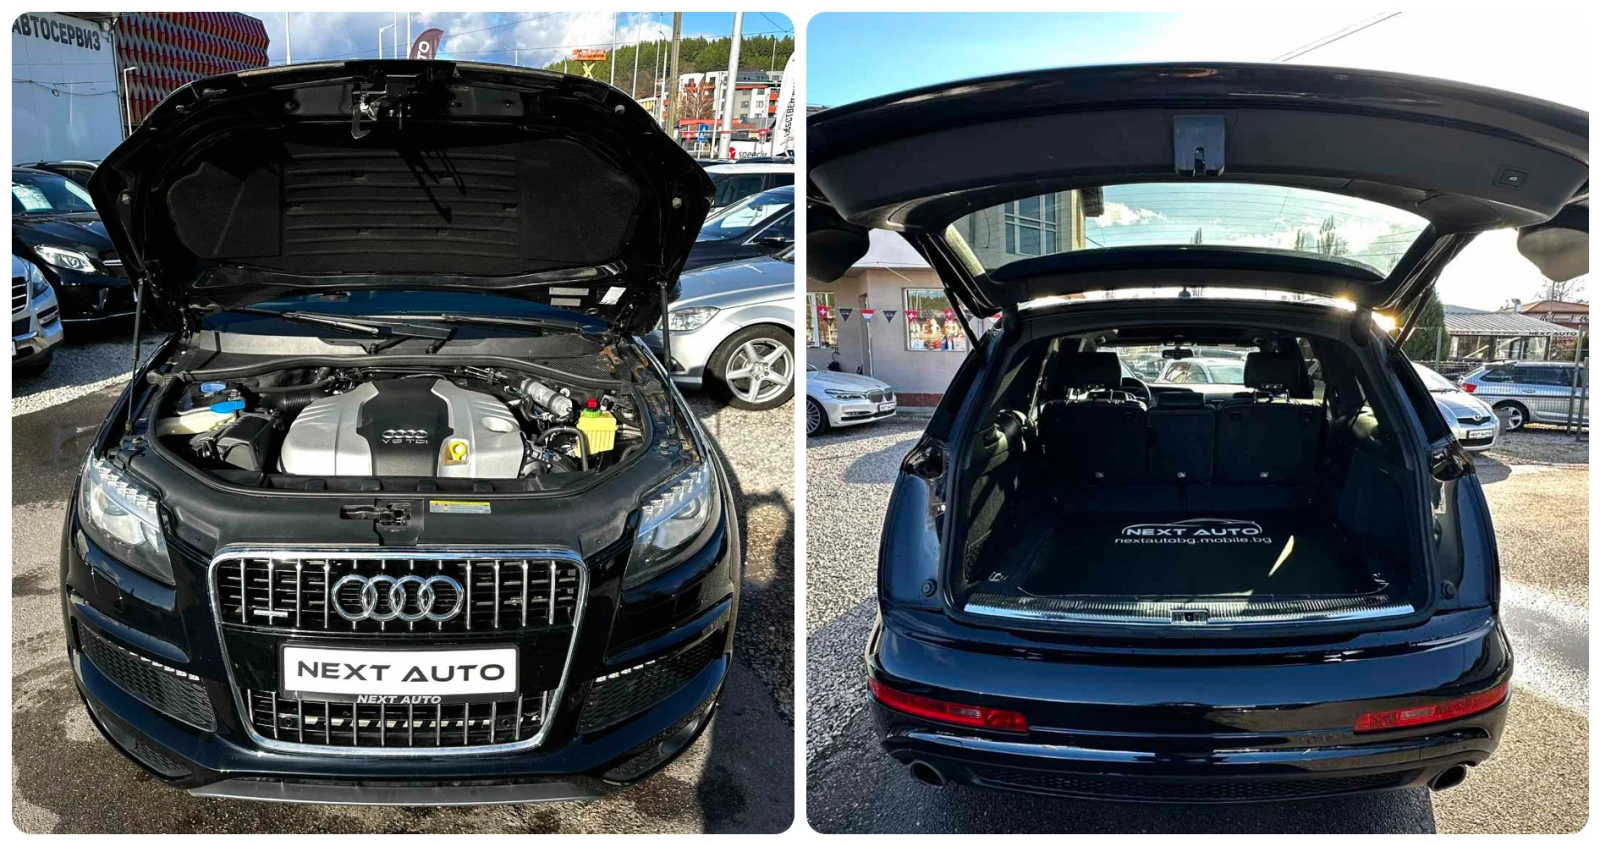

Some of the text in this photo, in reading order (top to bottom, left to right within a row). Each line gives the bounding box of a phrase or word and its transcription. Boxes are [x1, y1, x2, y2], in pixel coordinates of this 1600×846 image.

[12, 14, 101, 51] АВТОСЕРВИЗ
[1126, 528, 1260, 536] NEXT AUTO
[1114, 536, 1272, 545] nextautobg.mobile.bg
[297, 660, 505, 683] NEXT AUTO
[356, 694, 442, 704] NEXT AUTO
